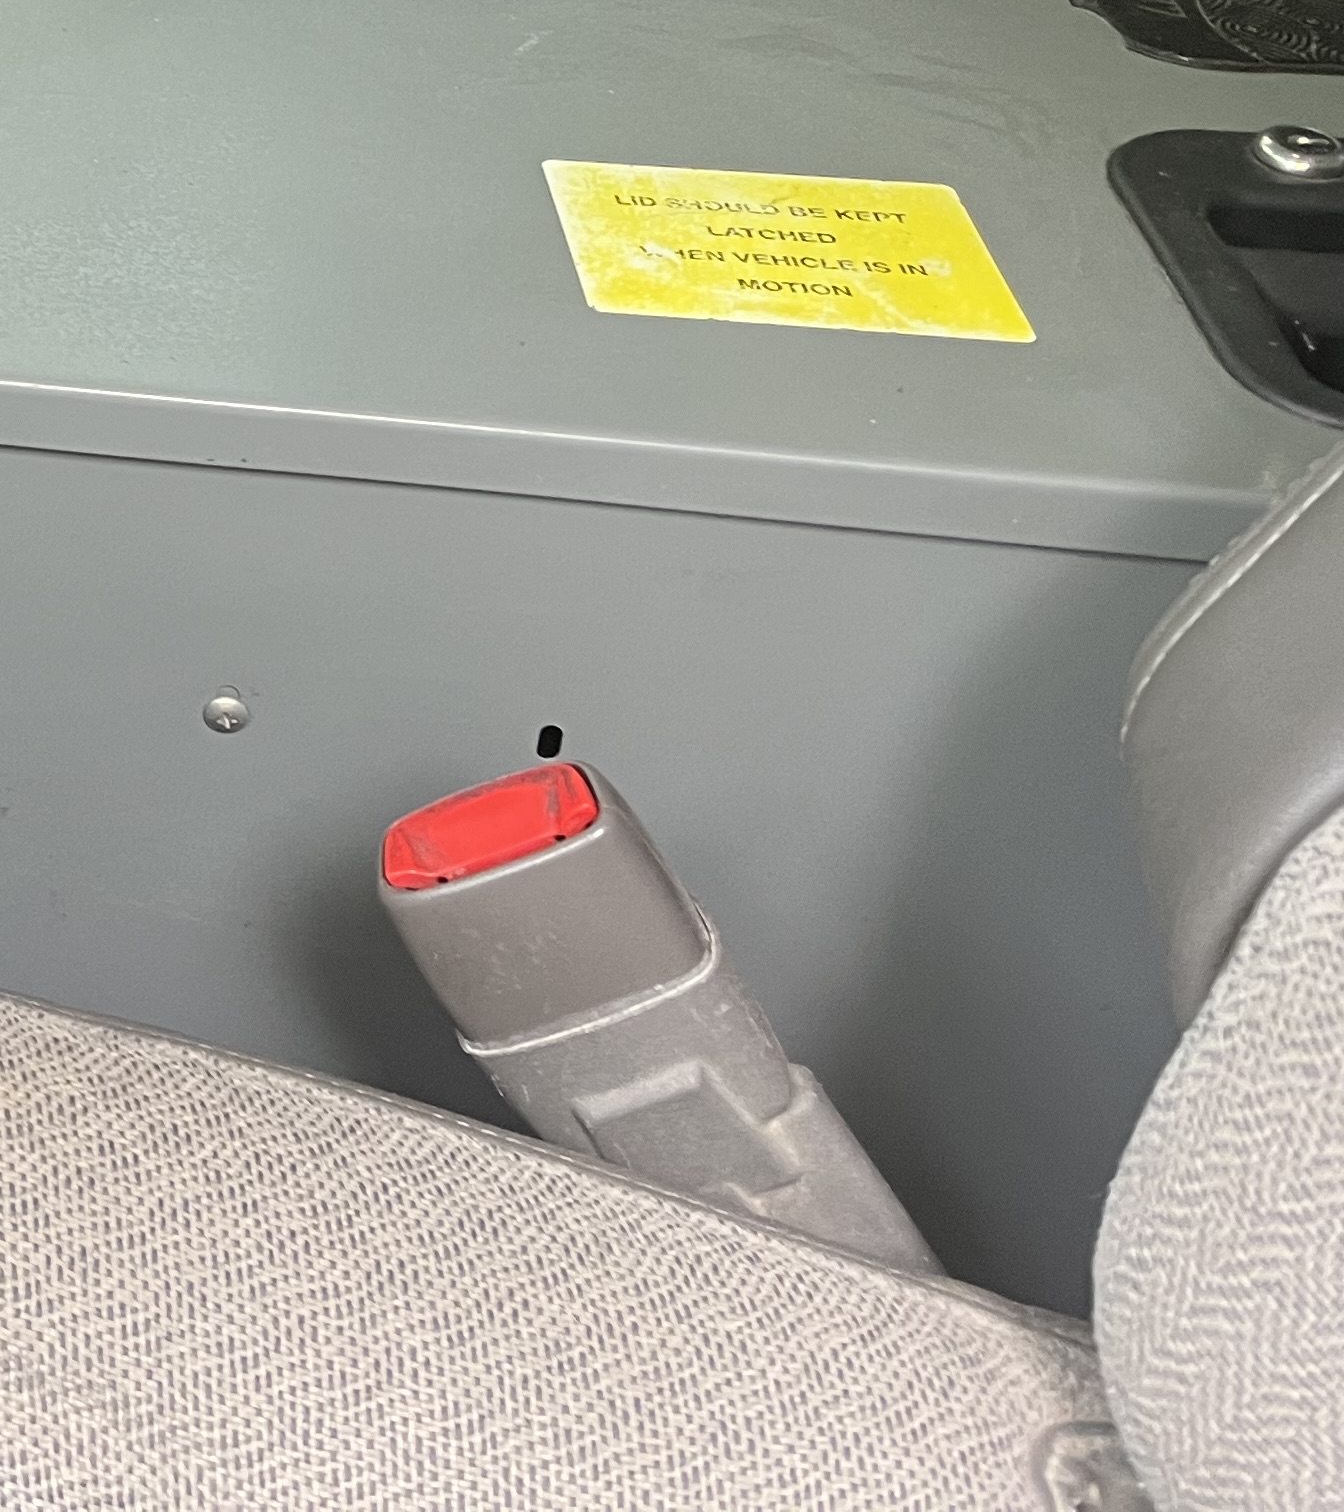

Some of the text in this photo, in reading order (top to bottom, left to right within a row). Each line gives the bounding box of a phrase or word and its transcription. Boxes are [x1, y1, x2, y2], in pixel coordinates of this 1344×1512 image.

[614, 194, 907, 225] LID SHOULD BE KEPT
[706, 224, 837, 245] LATCHED
[732, 251, 858, 273] VEHICLE
[864, 261, 892, 275] IS
[900, 263, 929, 277] IN
[737, 277, 853, 298] MOTION
